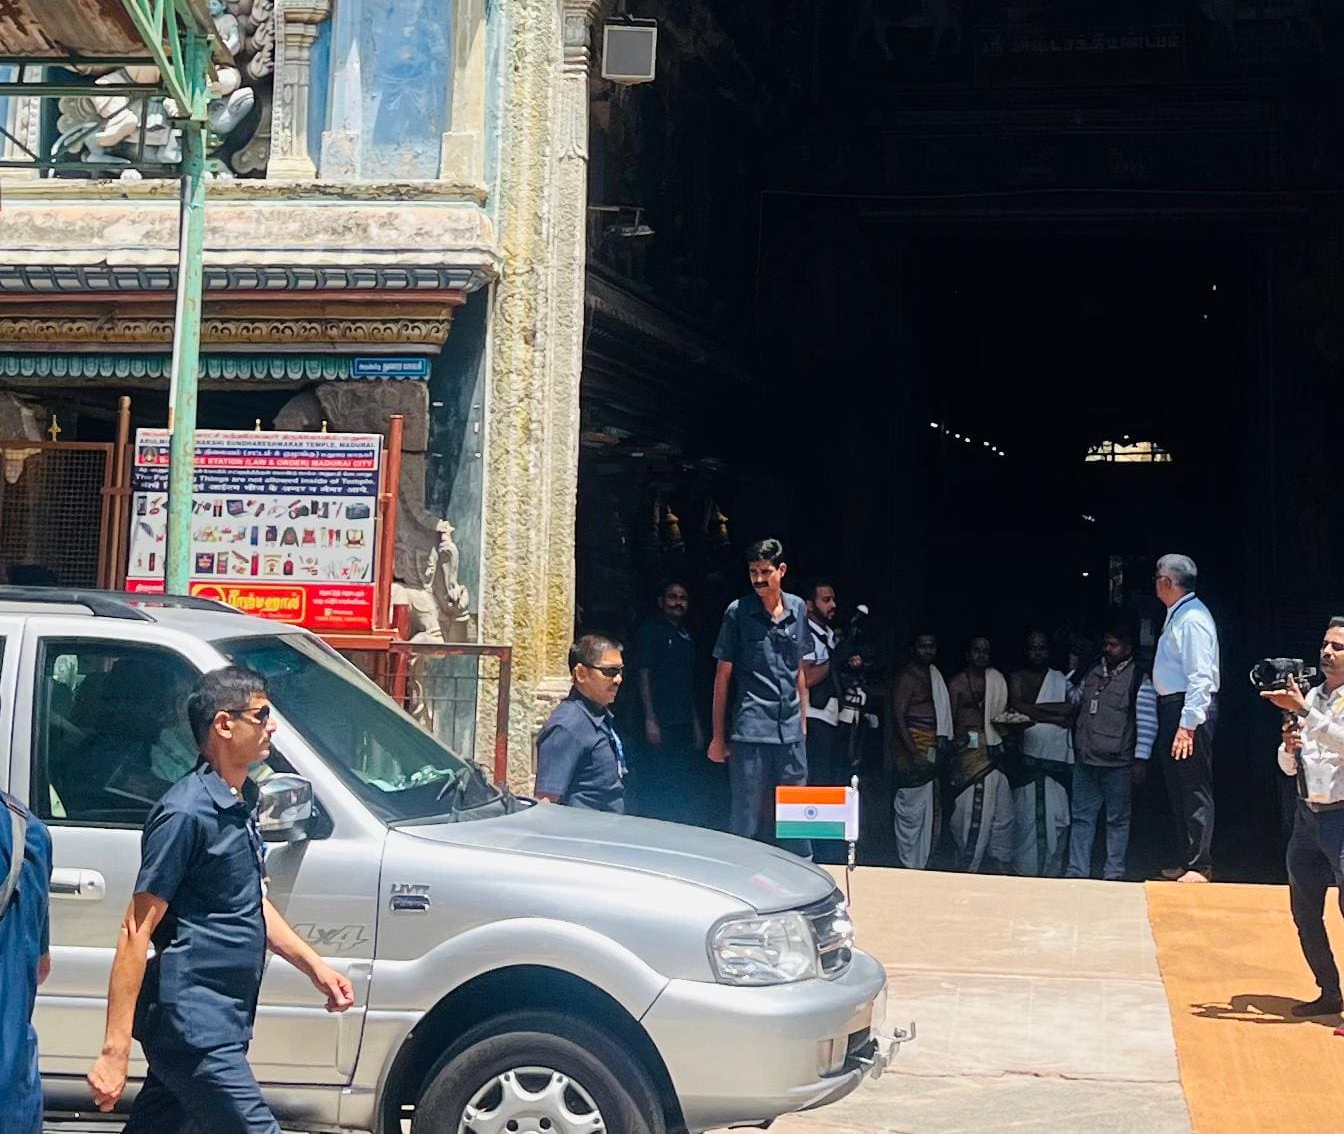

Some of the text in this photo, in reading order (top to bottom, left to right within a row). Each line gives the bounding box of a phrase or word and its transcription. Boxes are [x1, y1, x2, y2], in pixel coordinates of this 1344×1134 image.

[208, 457, 243, 465] STATION
[311, 459, 351, 467] MADURAI
[200, 475, 229, 483] Things
